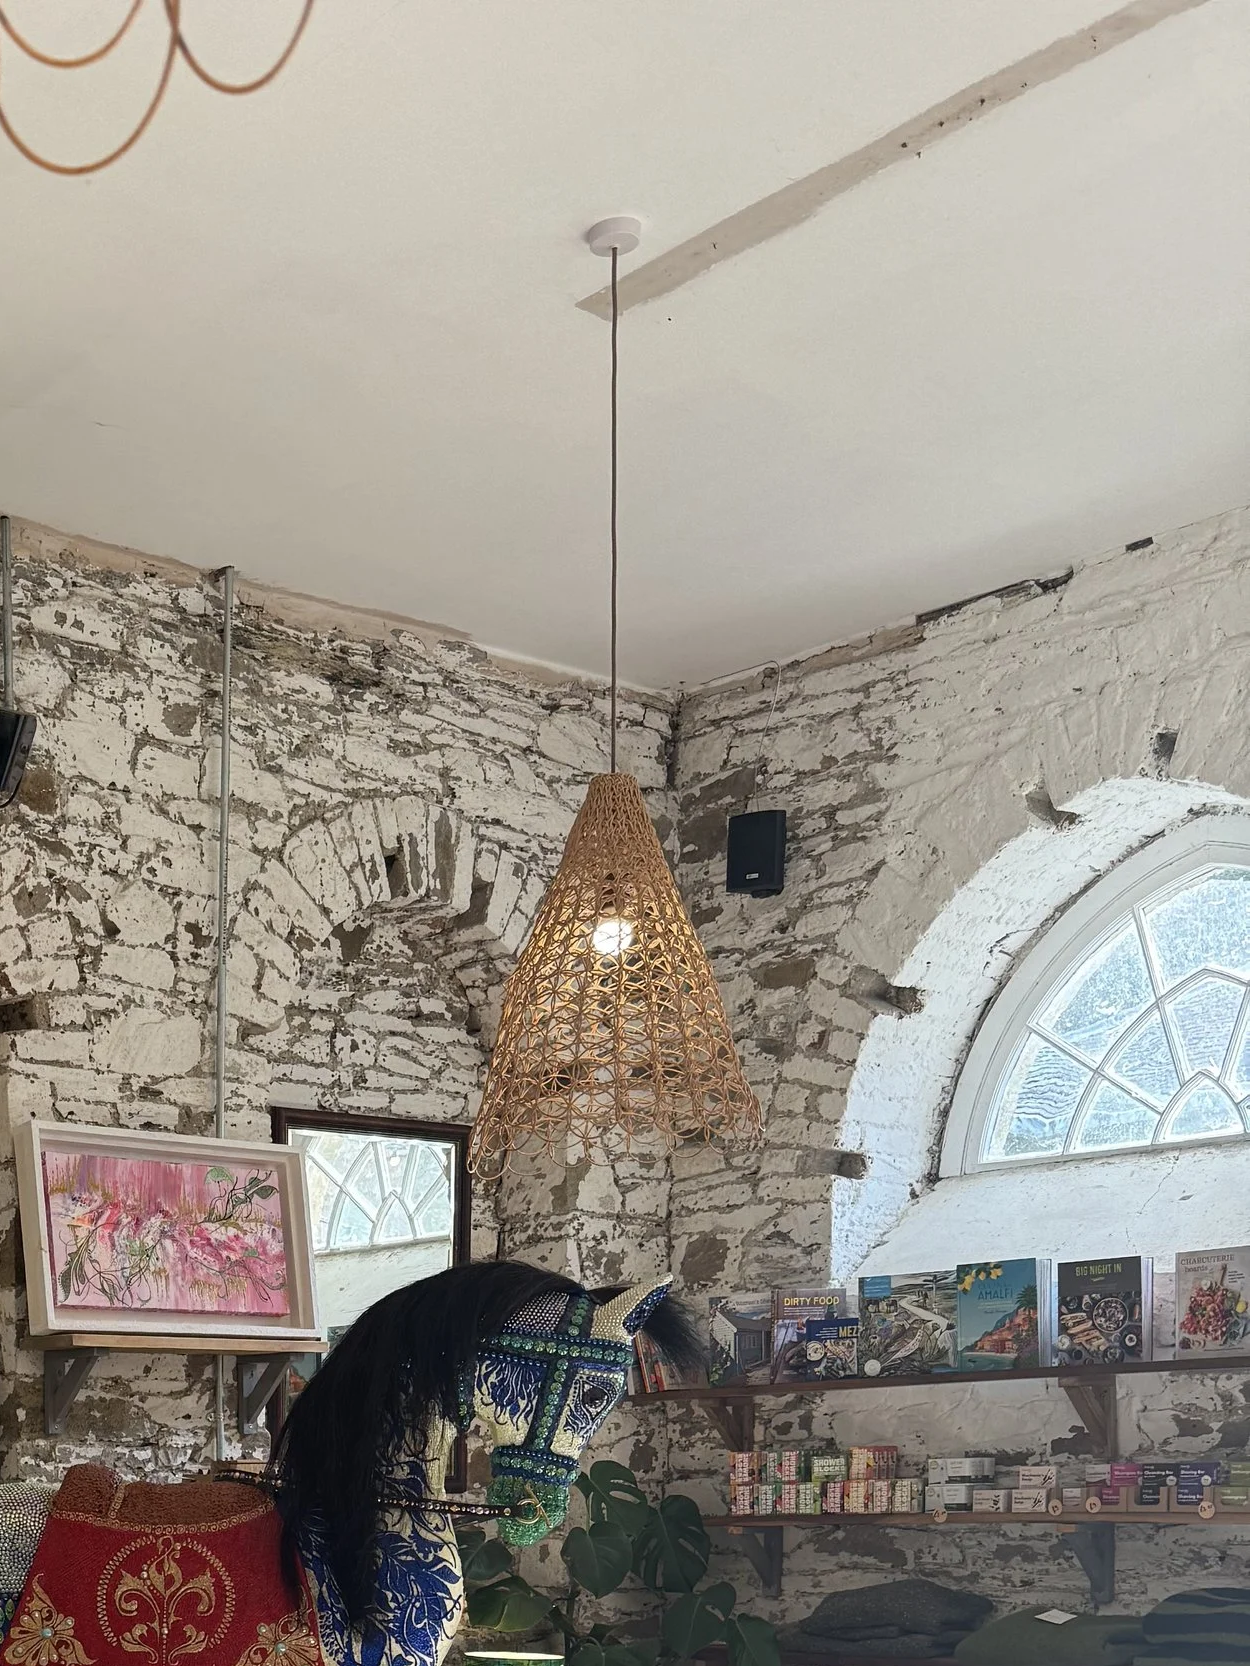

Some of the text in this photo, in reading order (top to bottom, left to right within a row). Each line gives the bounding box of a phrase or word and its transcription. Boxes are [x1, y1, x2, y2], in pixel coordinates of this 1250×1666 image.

[1180, 1254, 1235, 1265] CHARCUTERIE
[1075, 1263, 1122, 1277] BIG NIGHT IN
[1184, 1265, 1208, 1273] boards
[978, 1289, 1013, 1300] AMALFI
[784, 1296, 840, 1306] DIRTY FOOD
